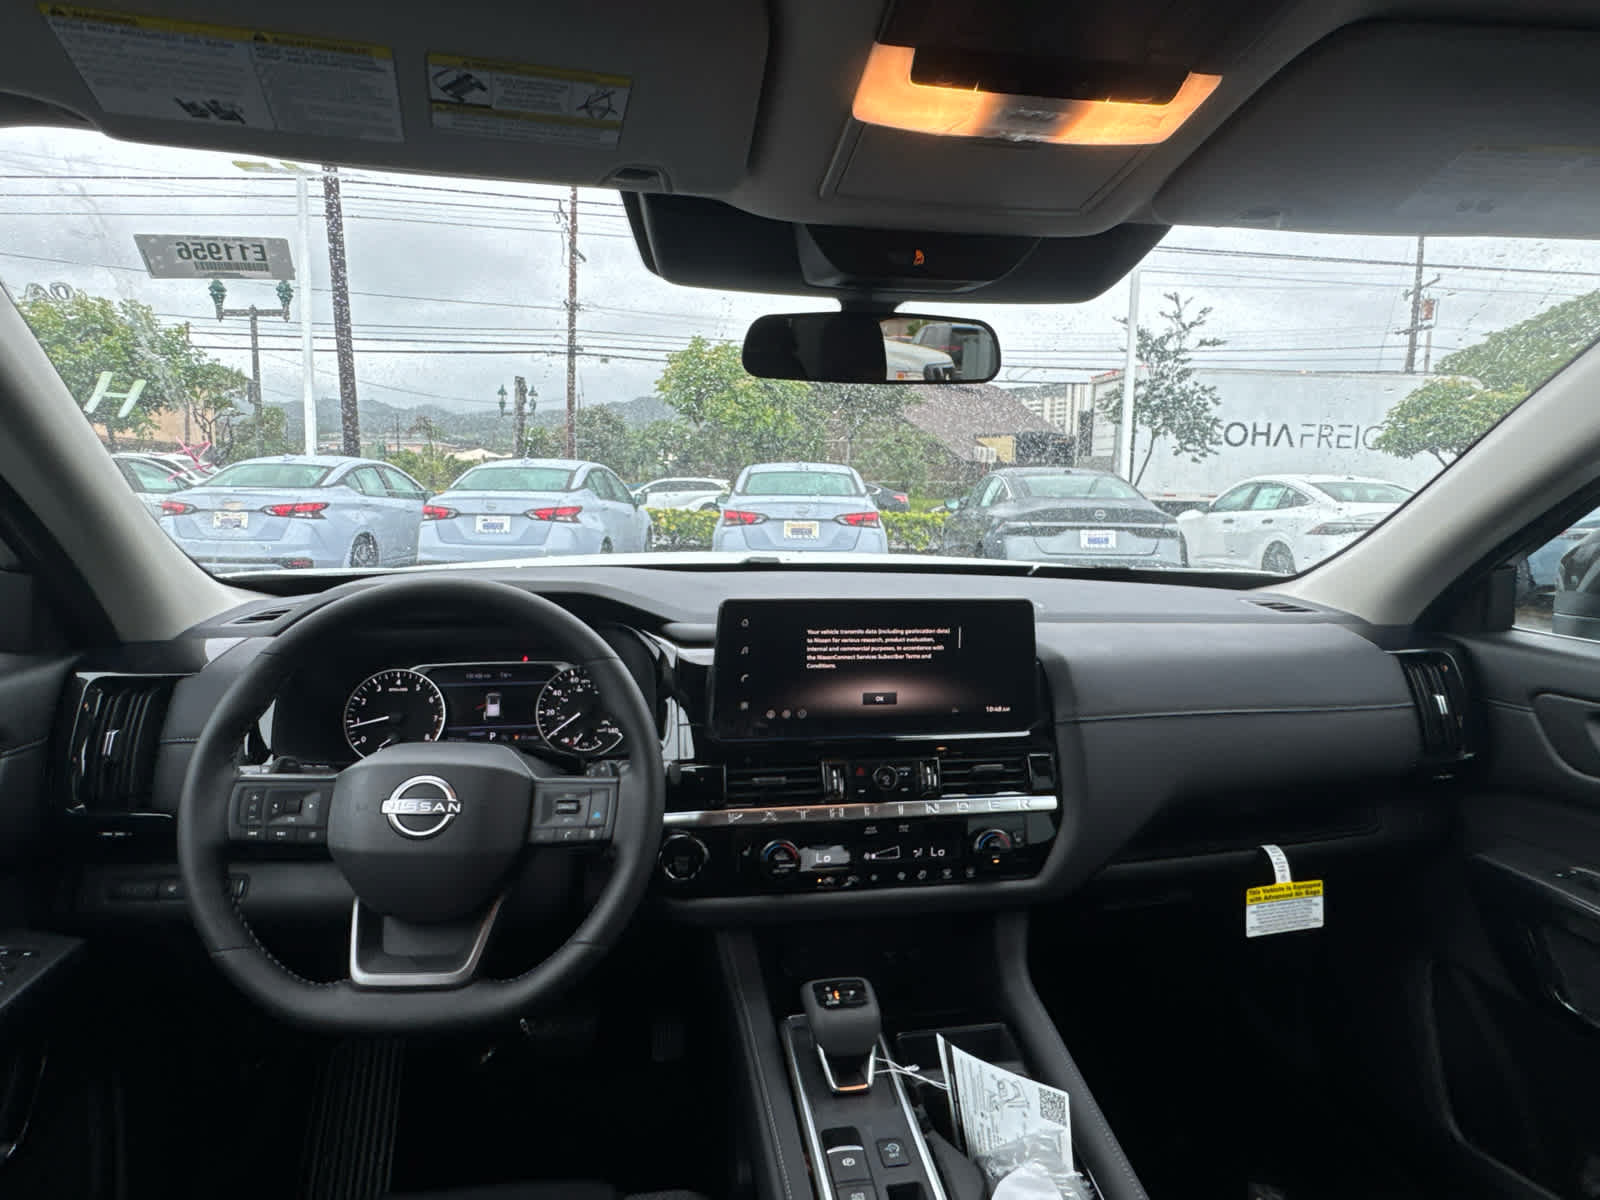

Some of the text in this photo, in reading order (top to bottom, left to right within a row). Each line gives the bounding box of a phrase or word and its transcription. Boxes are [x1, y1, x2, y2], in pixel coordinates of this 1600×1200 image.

[489, 732, 497, 741] P
[383, 801, 461, 813] NISSAN
[815, 851, 832, 863] Lo
